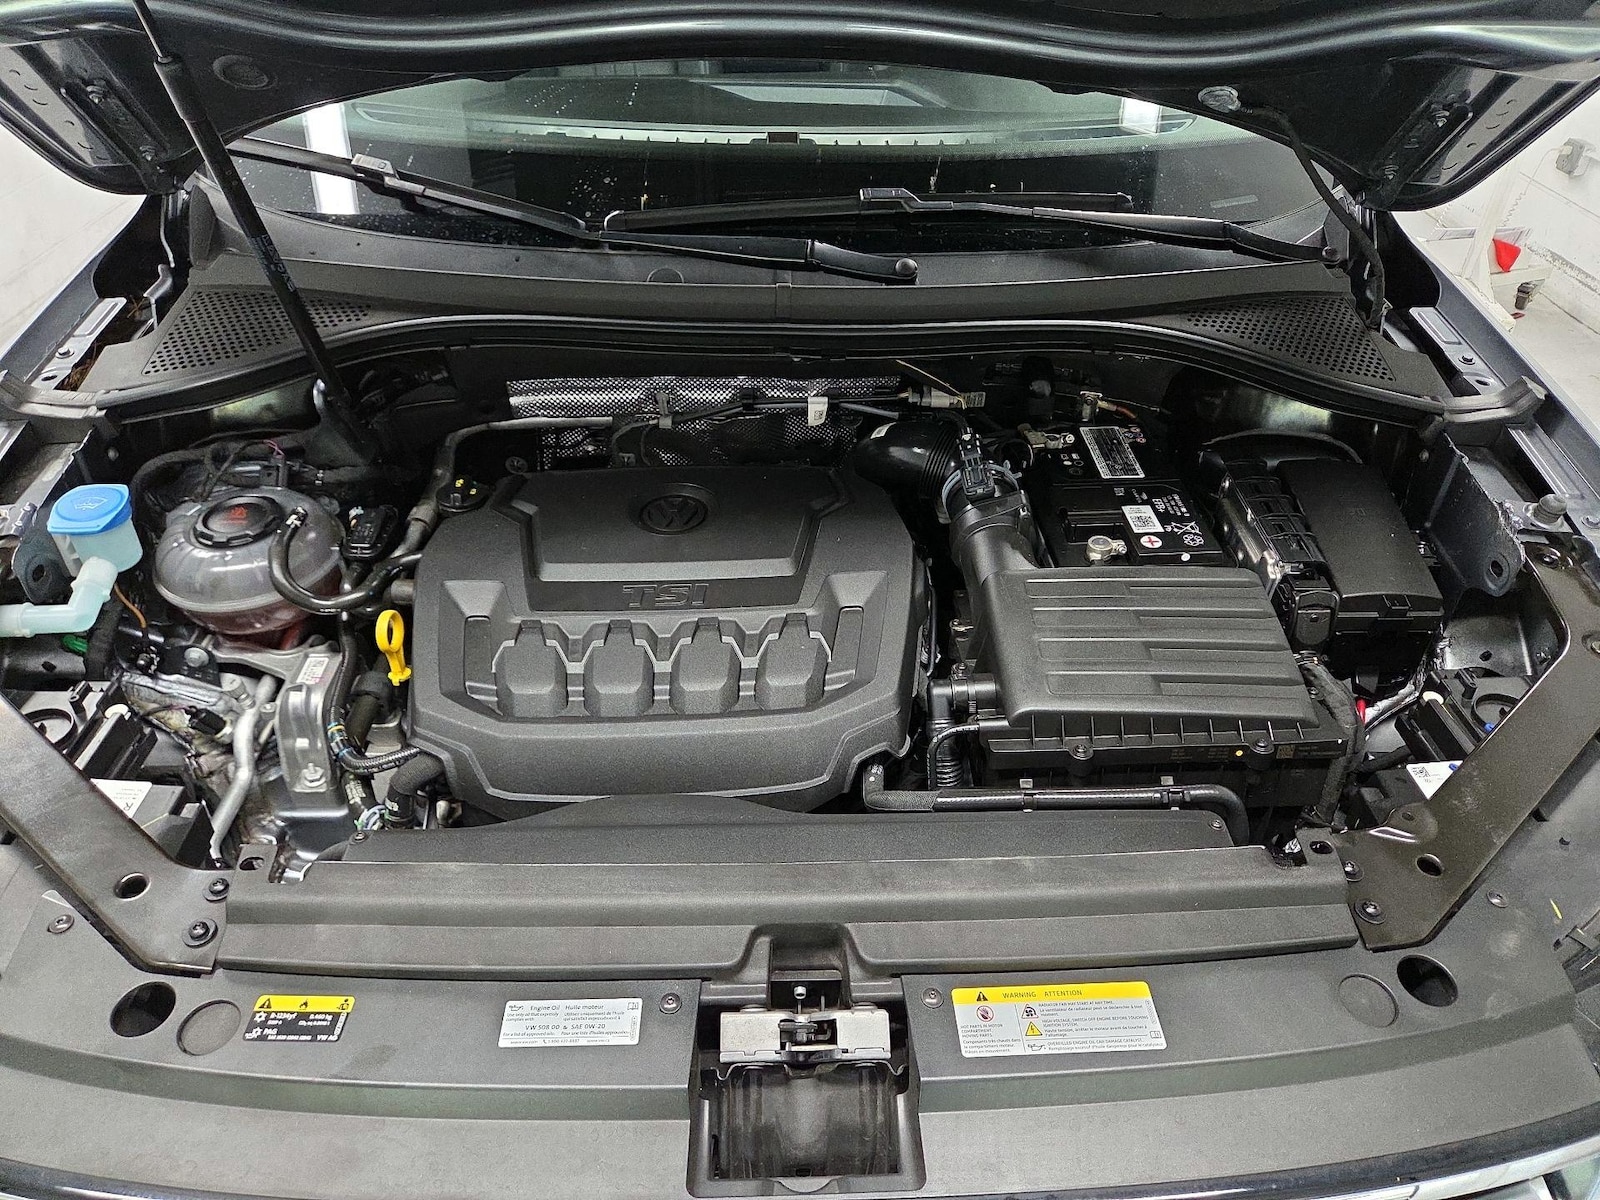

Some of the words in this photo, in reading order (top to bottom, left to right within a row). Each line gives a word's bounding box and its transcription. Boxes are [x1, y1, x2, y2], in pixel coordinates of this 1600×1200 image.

[622, 583, 710, 607] TSI
[1002, 991, 1037, 999] WARNING
[1044, 989, 1082, 997] ATTENTION
